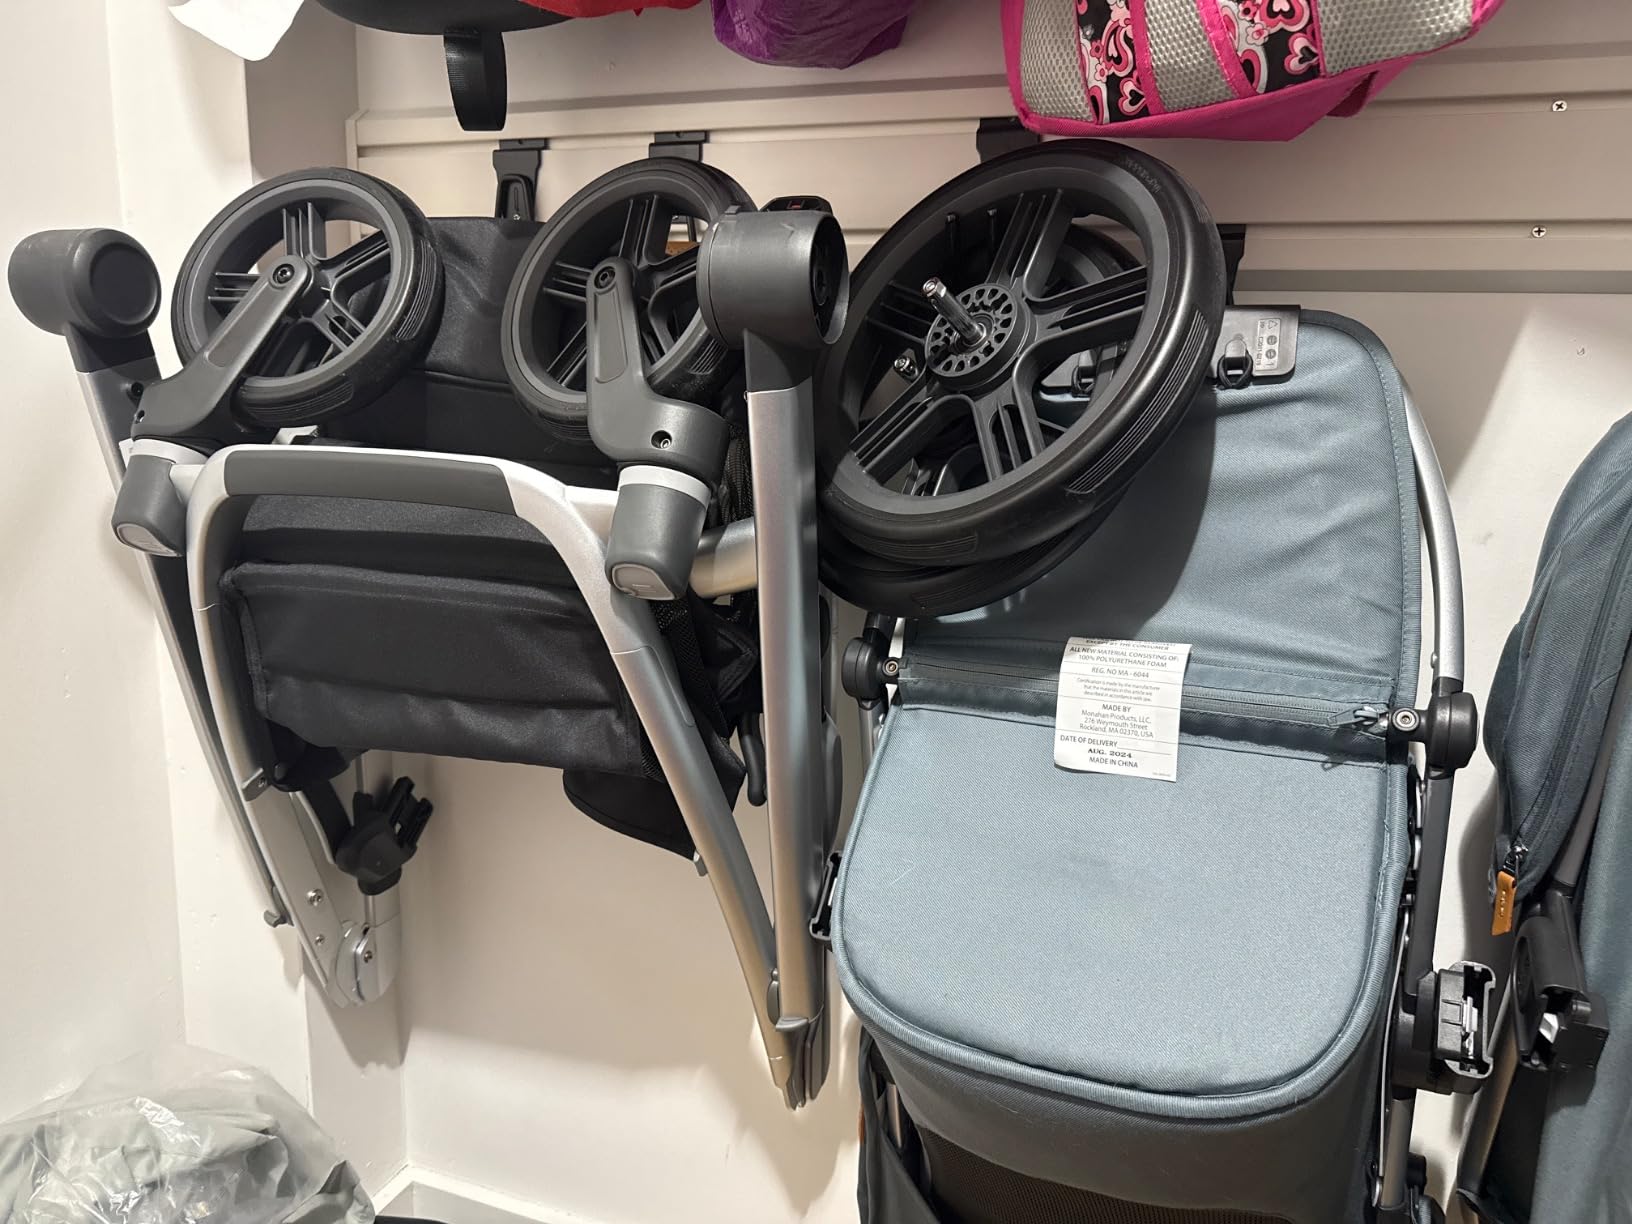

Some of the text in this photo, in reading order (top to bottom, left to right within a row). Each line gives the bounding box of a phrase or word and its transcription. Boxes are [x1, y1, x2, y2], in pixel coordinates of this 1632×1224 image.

[1098, 649, 1127, 657] MATERIAL
[1129, 652, 1167, 660] CONSISTING
[1096, 656, 1146, 666] POLYURETHANE
[1102, 704, 1121, 712] MADE
[1082, 710, 1109, 718] Monahan
[1110, 713, 1138, 722] Products,
[1096, 718, 1128, 728] Weymouth
[1120, 728, 1140, 736] 02370,
[1060, 734, 1077, 742] DATE
[1088, 738, 1118, 747] DELIVERY
[1089, 756, 1109, 764] MADE
[1118, 760, 1138, 768] CHINA
